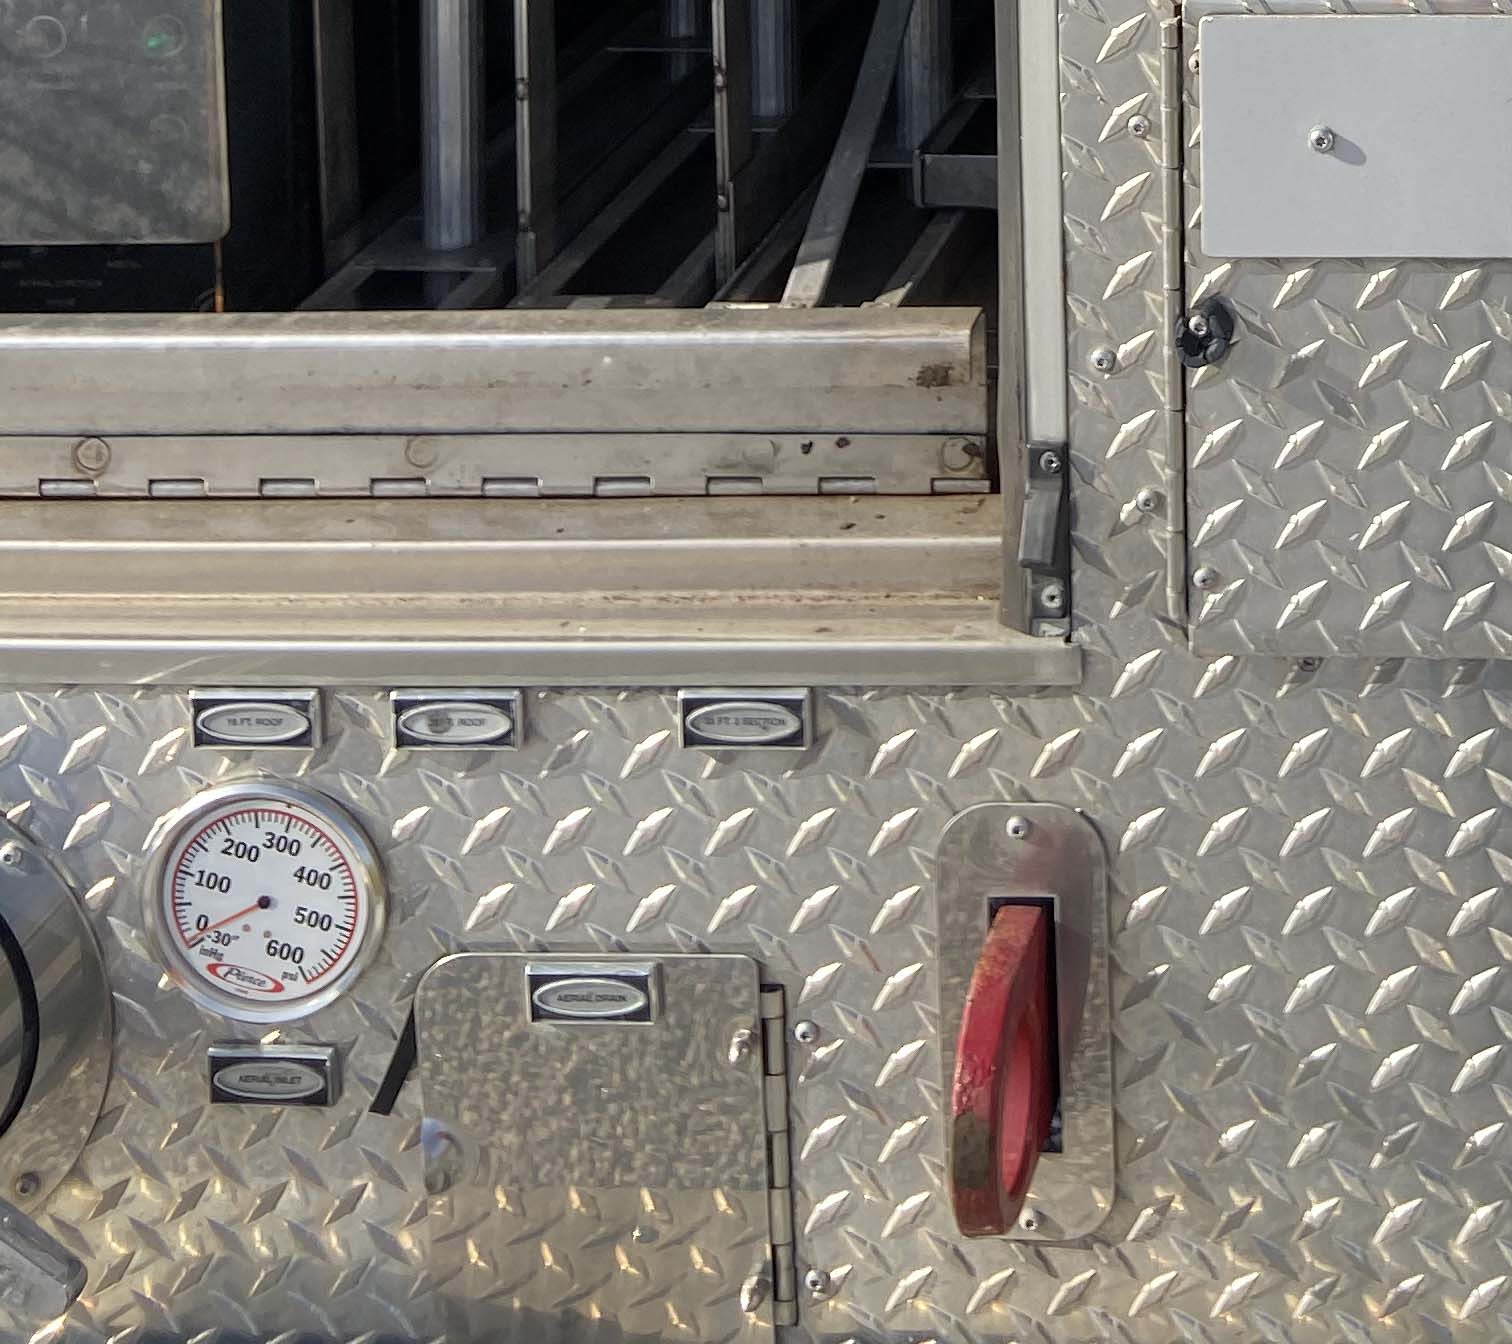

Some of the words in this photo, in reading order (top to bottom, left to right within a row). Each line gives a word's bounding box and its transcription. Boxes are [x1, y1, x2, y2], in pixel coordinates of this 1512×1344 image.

[221, 838, 260, 863] 200
[262, 832, 301, 856] 300
[195, 870, 231, 893] 100
[294, 866, 331, 890] 400
[196, 914, 209, 932] 0
[294, 906, 332, 932] 500
[266, 939, 304, 964] 600
[281, 970, 299, 982] psi
